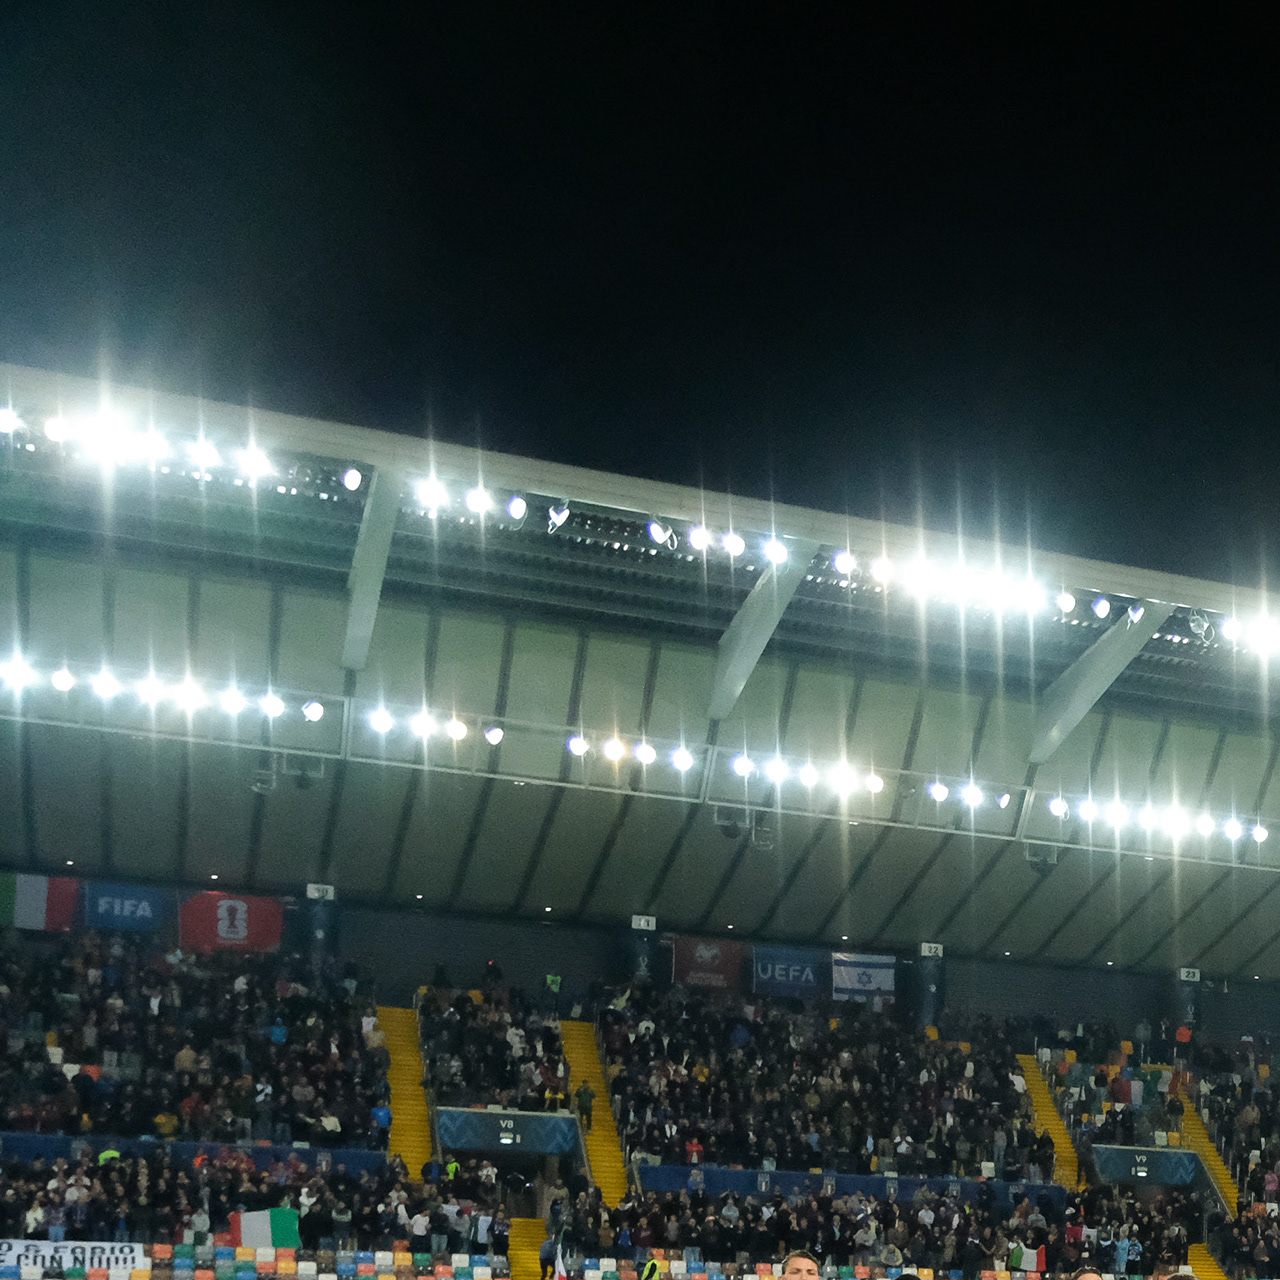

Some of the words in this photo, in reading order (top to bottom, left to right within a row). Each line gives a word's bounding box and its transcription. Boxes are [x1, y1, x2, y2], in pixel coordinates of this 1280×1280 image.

[98, 896, 153, 918] FIFA
[928, 946, 939, 954] 22
[757, 962, 814, 983] UEFA
[1185, 971, 1196, 979] 23
[499, 1119, 514, 1129] V8
[1135, 1155, 1147, 1163] V9
